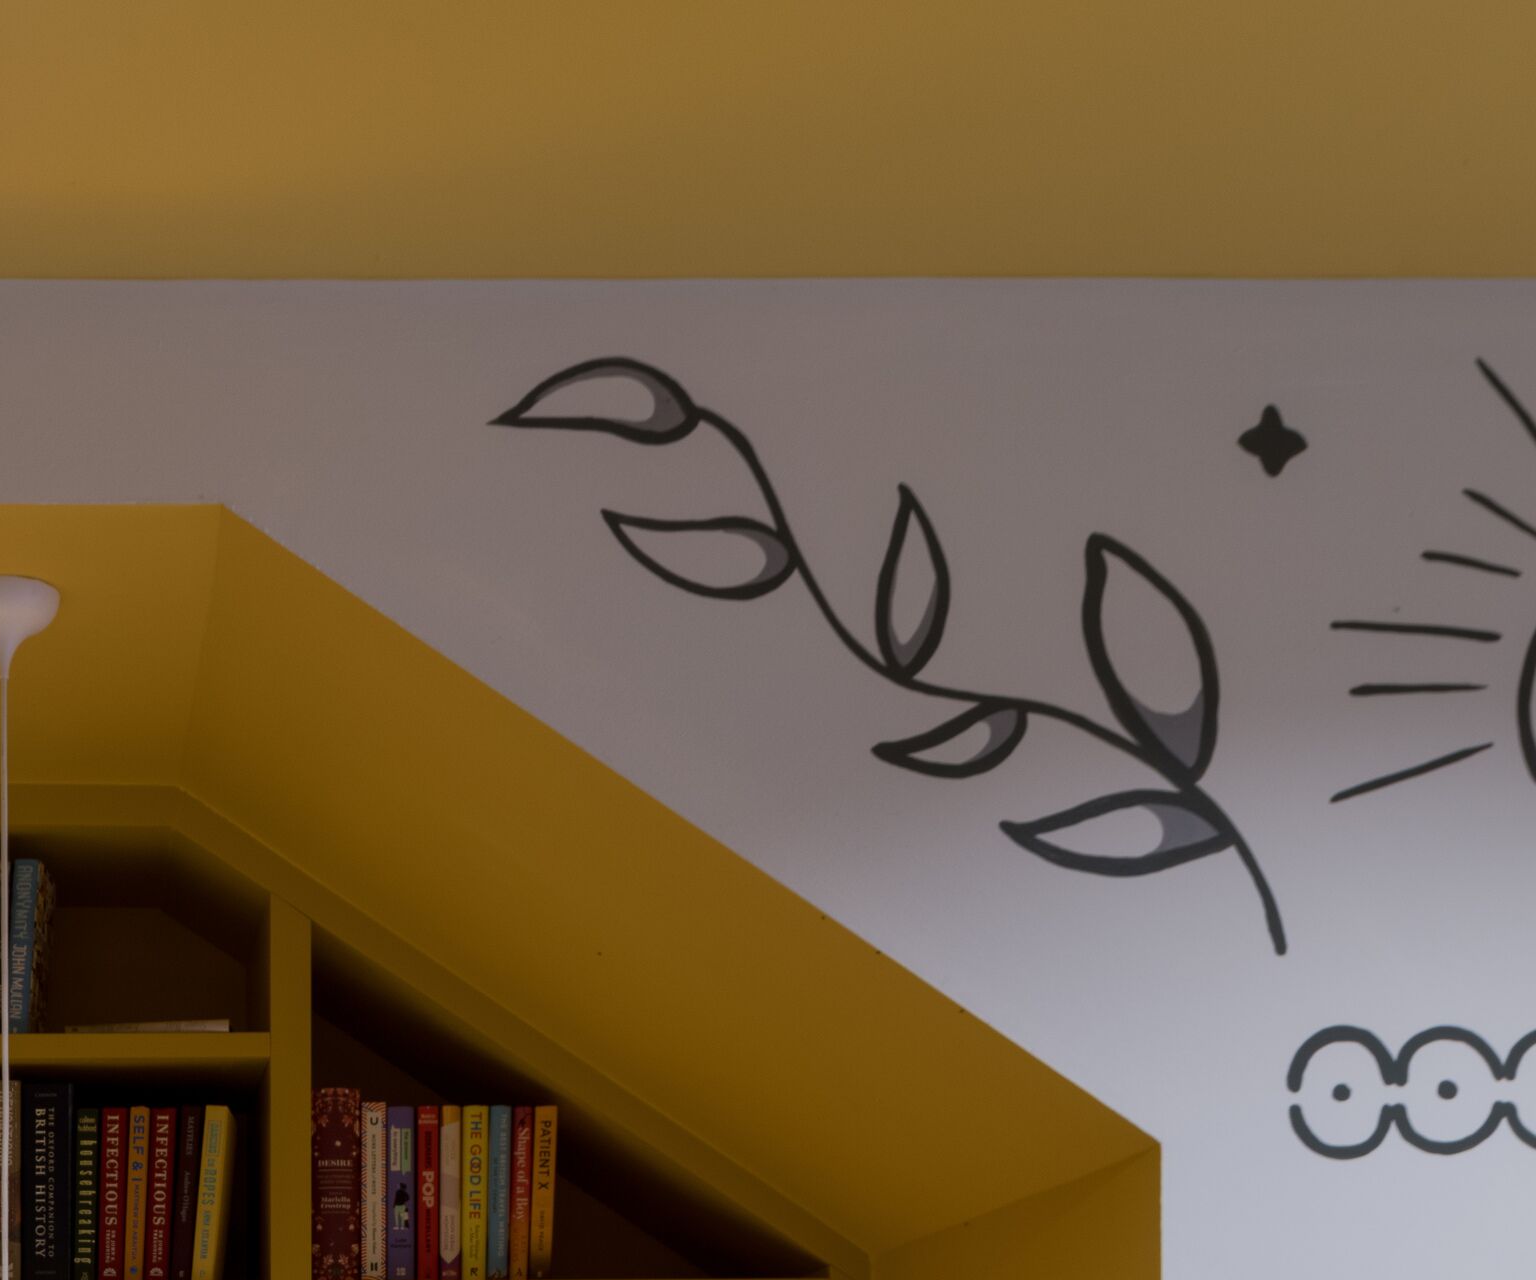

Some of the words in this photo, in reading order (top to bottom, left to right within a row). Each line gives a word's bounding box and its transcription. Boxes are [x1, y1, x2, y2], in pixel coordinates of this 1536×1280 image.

[35, 1108, 46, 1175] BRITISH
[105, 1115, 119, 1225] INFECTIOUS
[153, 1115, 169, 1225] INFECTIOUS
[539, 1120, 551, 1176] PATIENT
[538, 1178, 549, 1190] X
[35, 1185, 46, 1257] HISTORY
